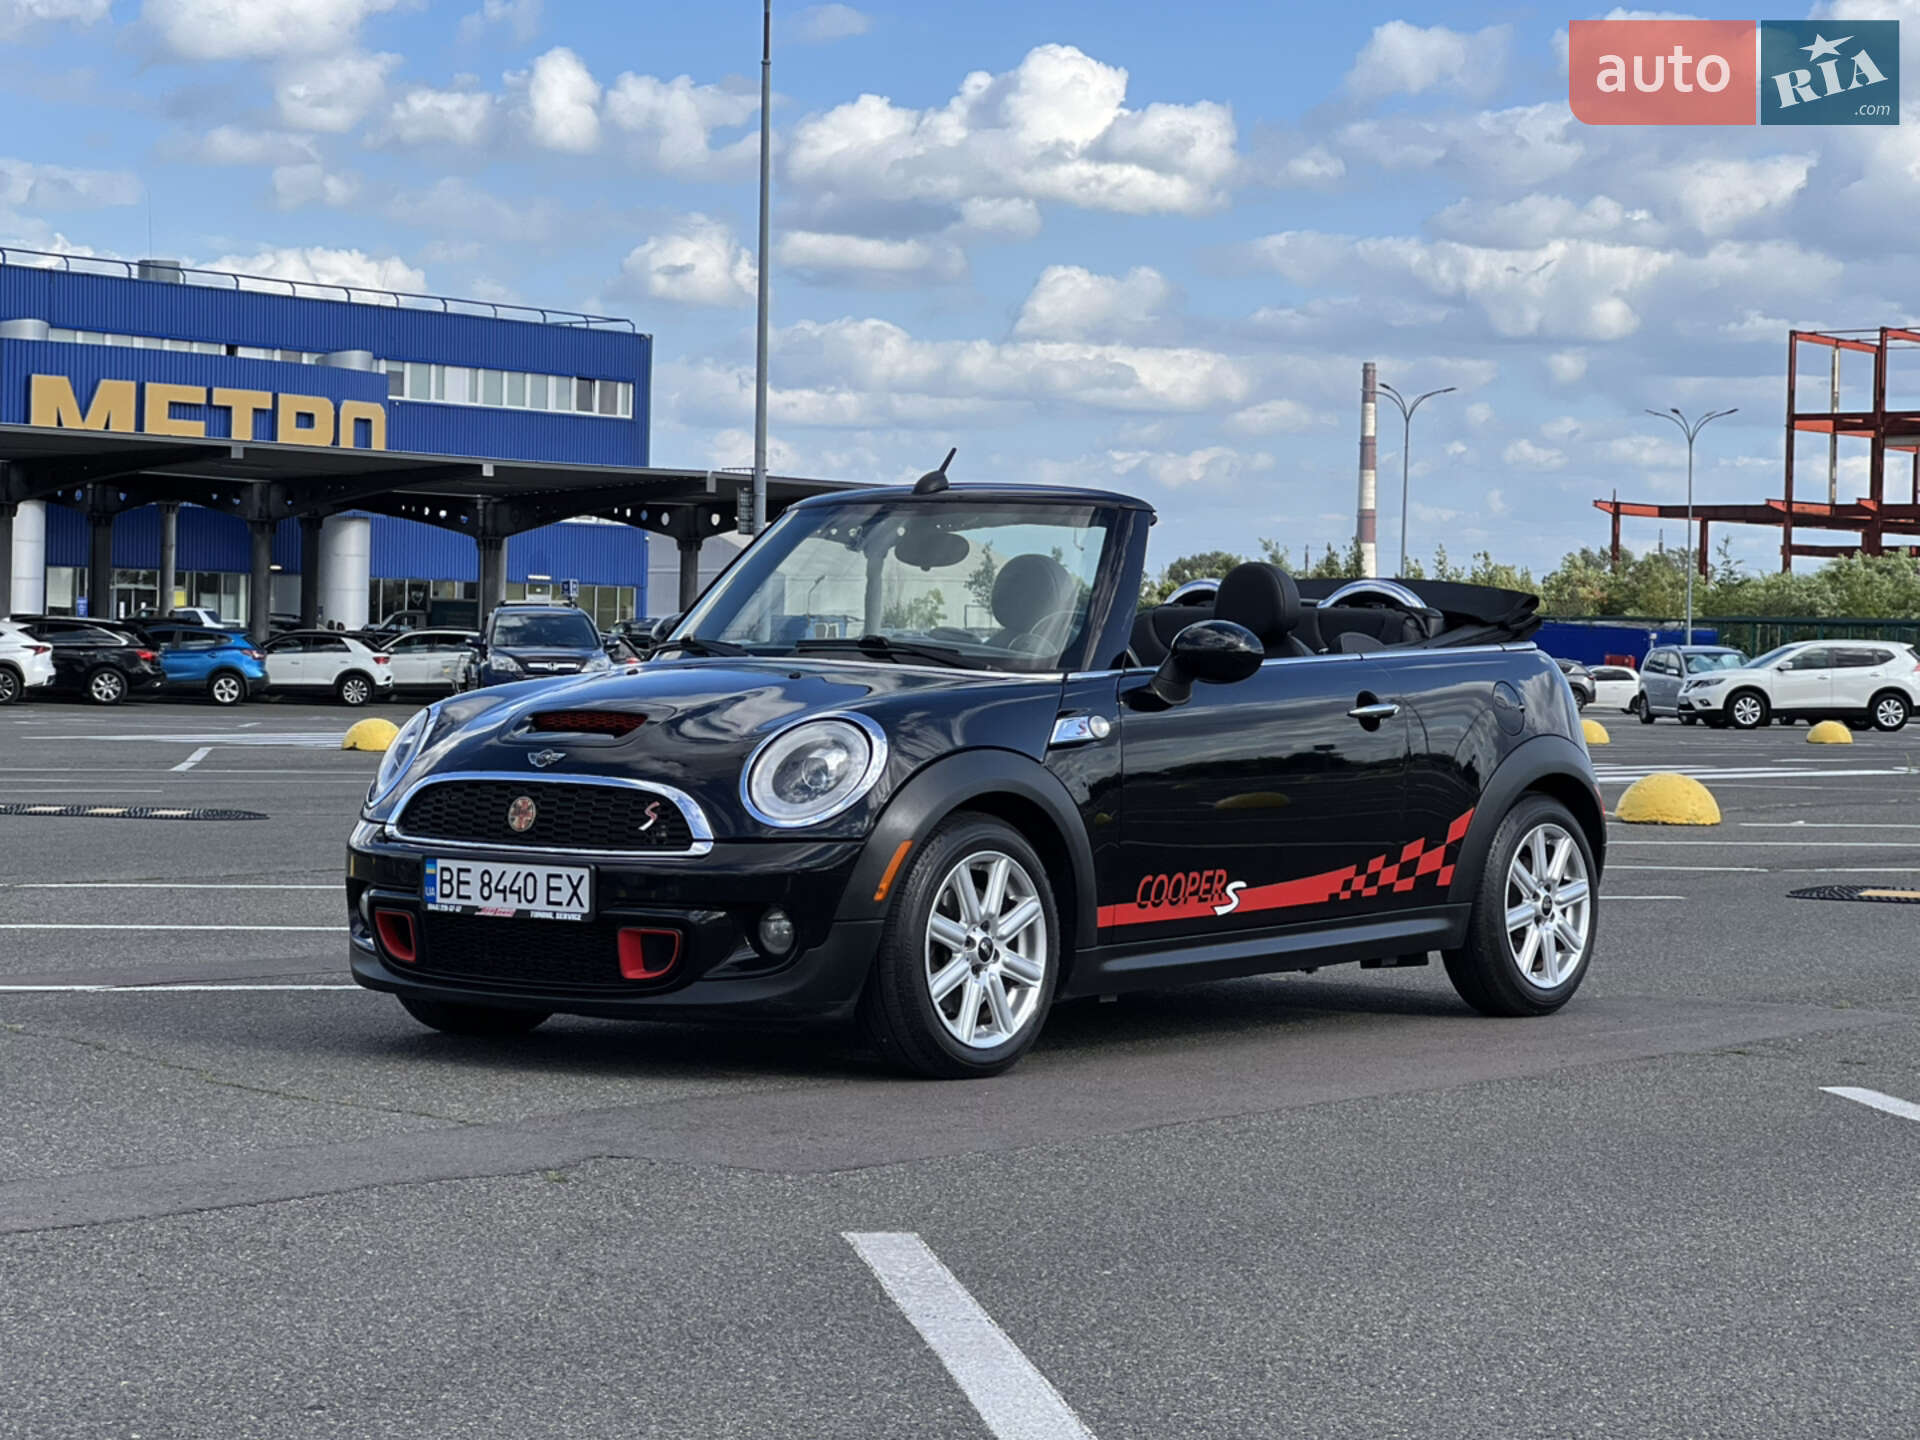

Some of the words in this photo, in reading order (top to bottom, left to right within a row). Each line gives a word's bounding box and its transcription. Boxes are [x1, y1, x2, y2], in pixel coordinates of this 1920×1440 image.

[31, 373, 386, 451] METRO
[425, 886, 436, 897] UA
[439, 866, 472, 900] BE
[479, 869, 538, 904] 8440
[546, 873, 585, 908] EX
[1136, 868, 1228, 909] COOPER
[1213, 880, 1247, 916] S
